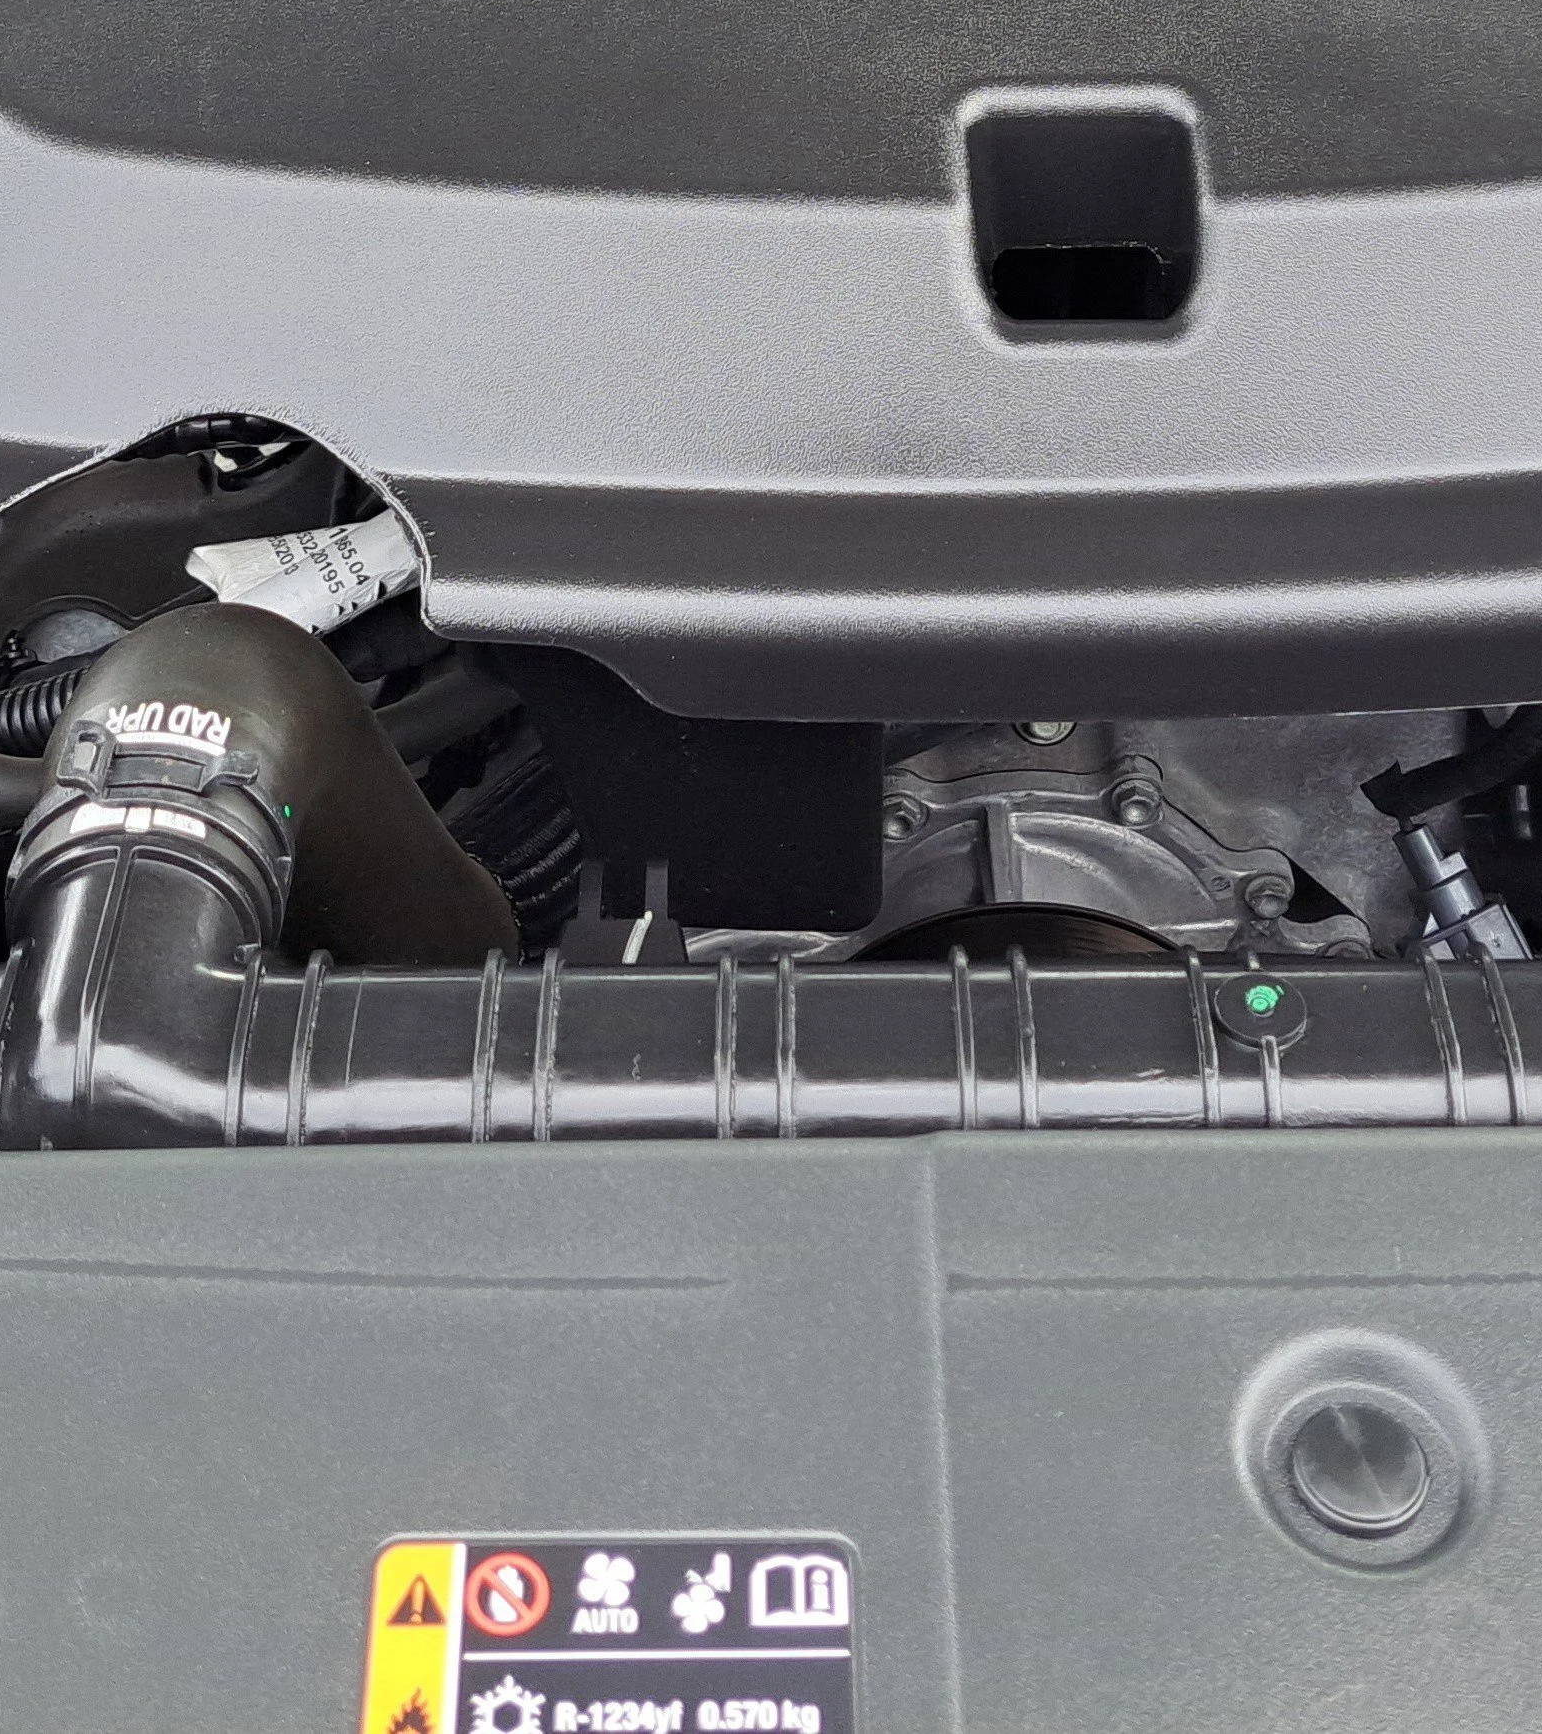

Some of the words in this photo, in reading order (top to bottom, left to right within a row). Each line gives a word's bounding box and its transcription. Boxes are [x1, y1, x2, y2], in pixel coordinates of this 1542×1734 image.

[105, 701, 165, 734] UPR
[168, 703, 231, 746] RAD
[569, 1607, 640, 1635] AUTO
[553, 1699, 685, 1734] R-1234yf
[696, 1699, 778, 1731] 0.570
[780, 1698, 821, 1734] kg
